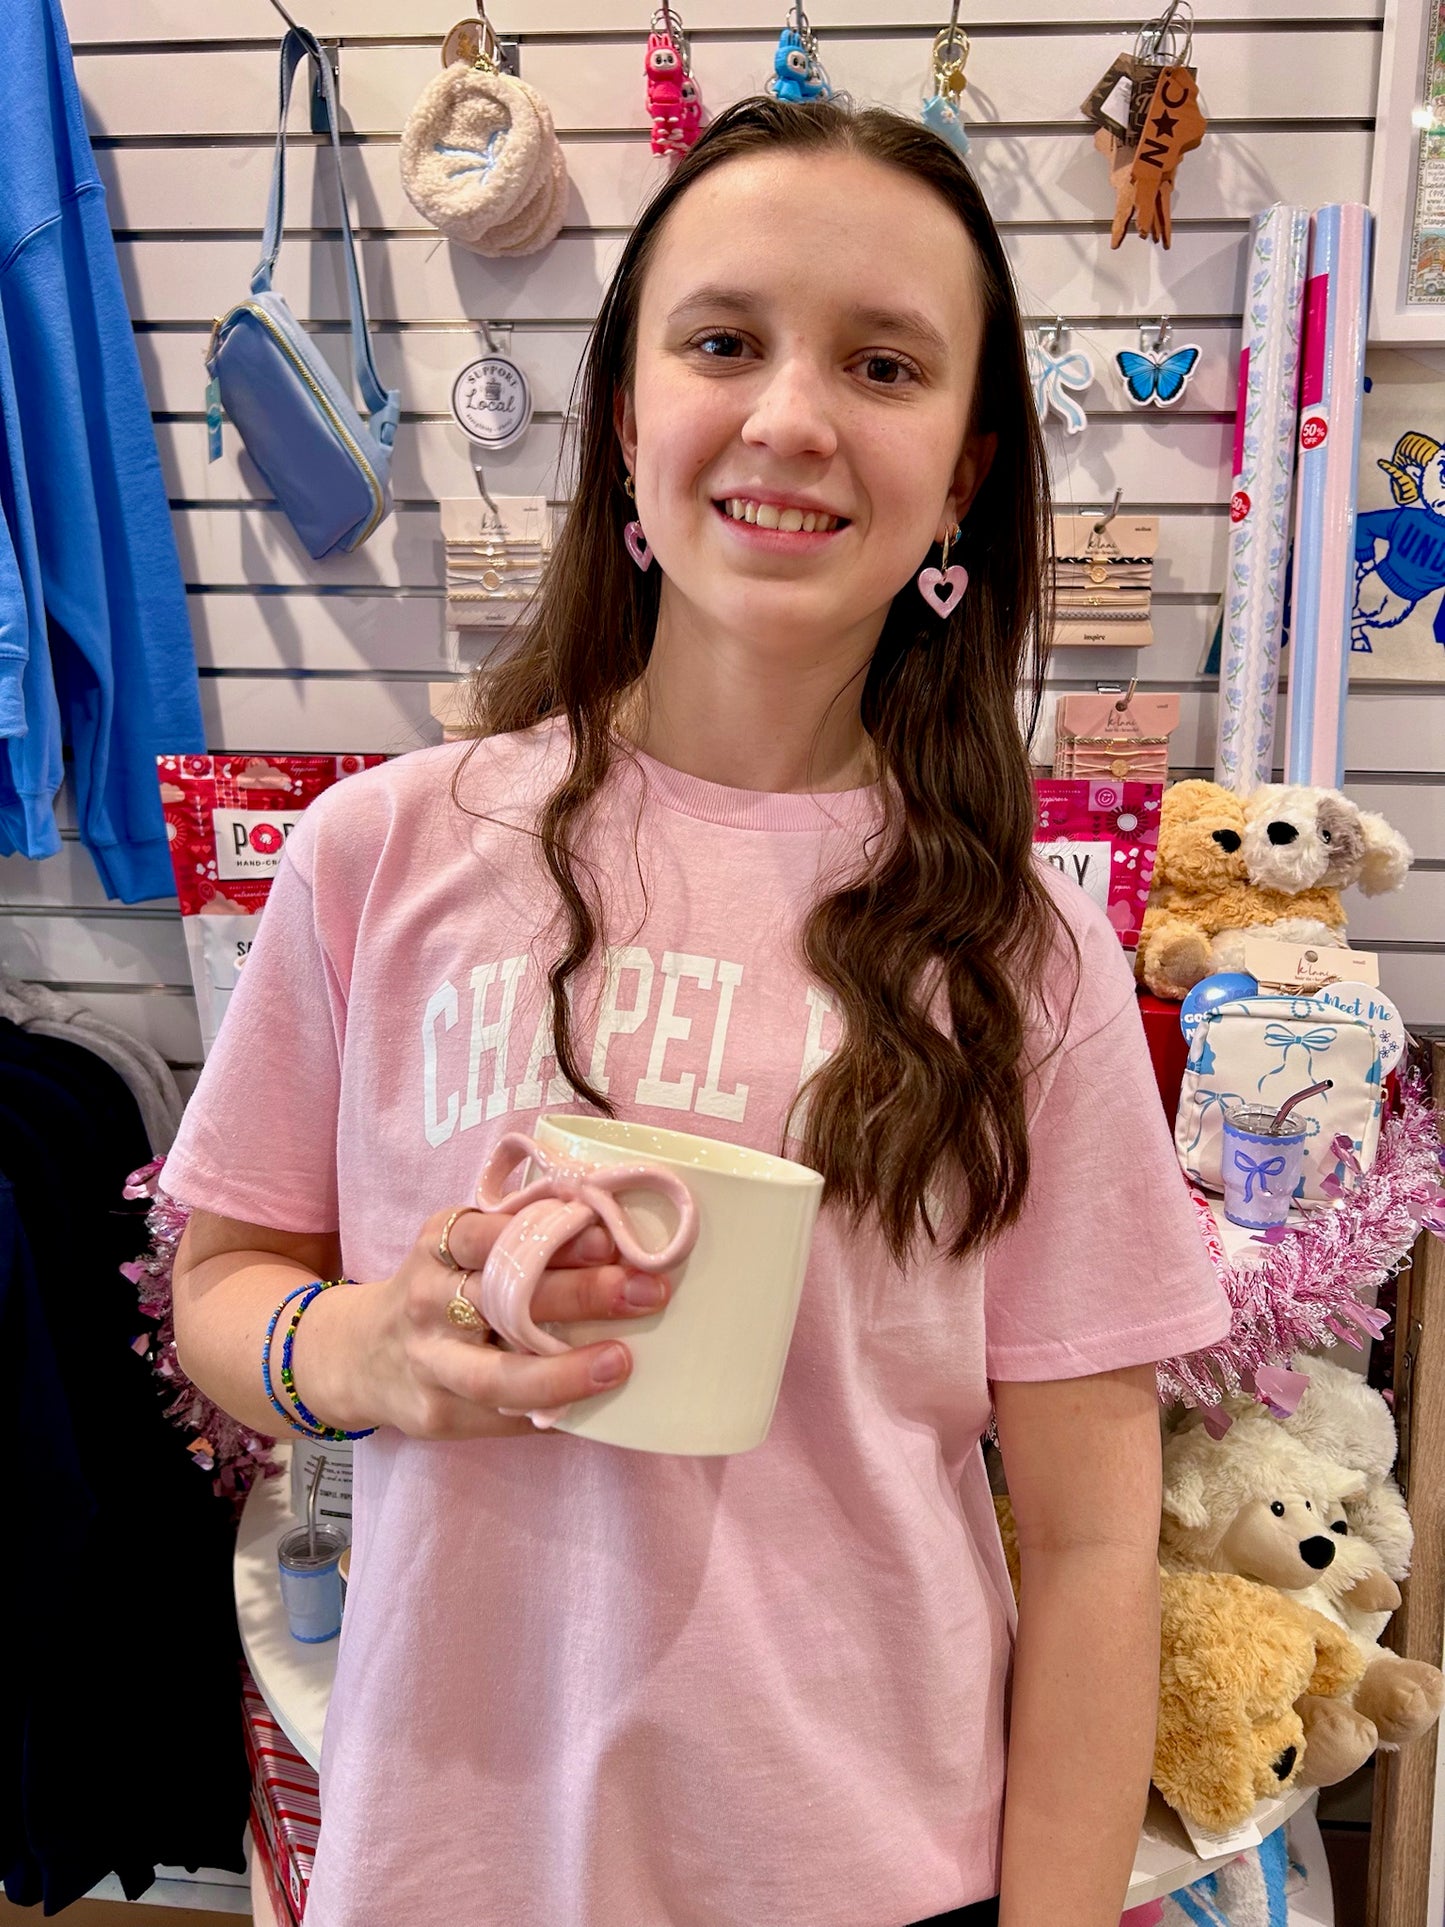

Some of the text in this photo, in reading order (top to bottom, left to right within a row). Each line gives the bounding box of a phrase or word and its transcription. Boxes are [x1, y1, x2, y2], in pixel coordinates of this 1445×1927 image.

[468, 365, 518, 388] SUPPORT
[465, 388, 516, 412] Local
[1303, 422, 1325, 438] 50%
[1304, 437, 1318, 445] OFF
[1323, 992, 1393, 1021] Meet Me
[422, 946, 749, 1149] CHAPEL
